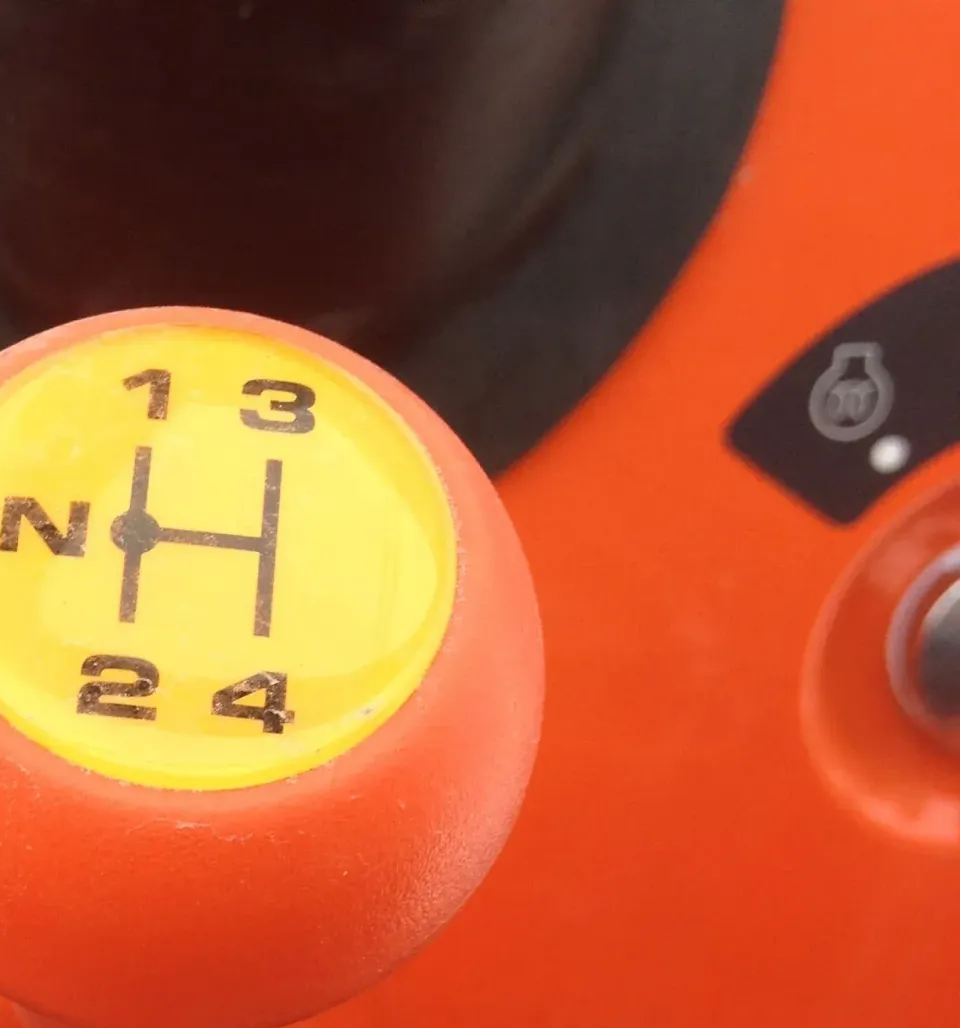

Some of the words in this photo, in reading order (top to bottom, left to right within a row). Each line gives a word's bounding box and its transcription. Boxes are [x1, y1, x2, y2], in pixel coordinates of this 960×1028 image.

[123, 369, 171, 420] 1
[240, 379, 316, 434] 3
[76, 654, 160, 721] 2
[211, 671, 295, 735] 4
